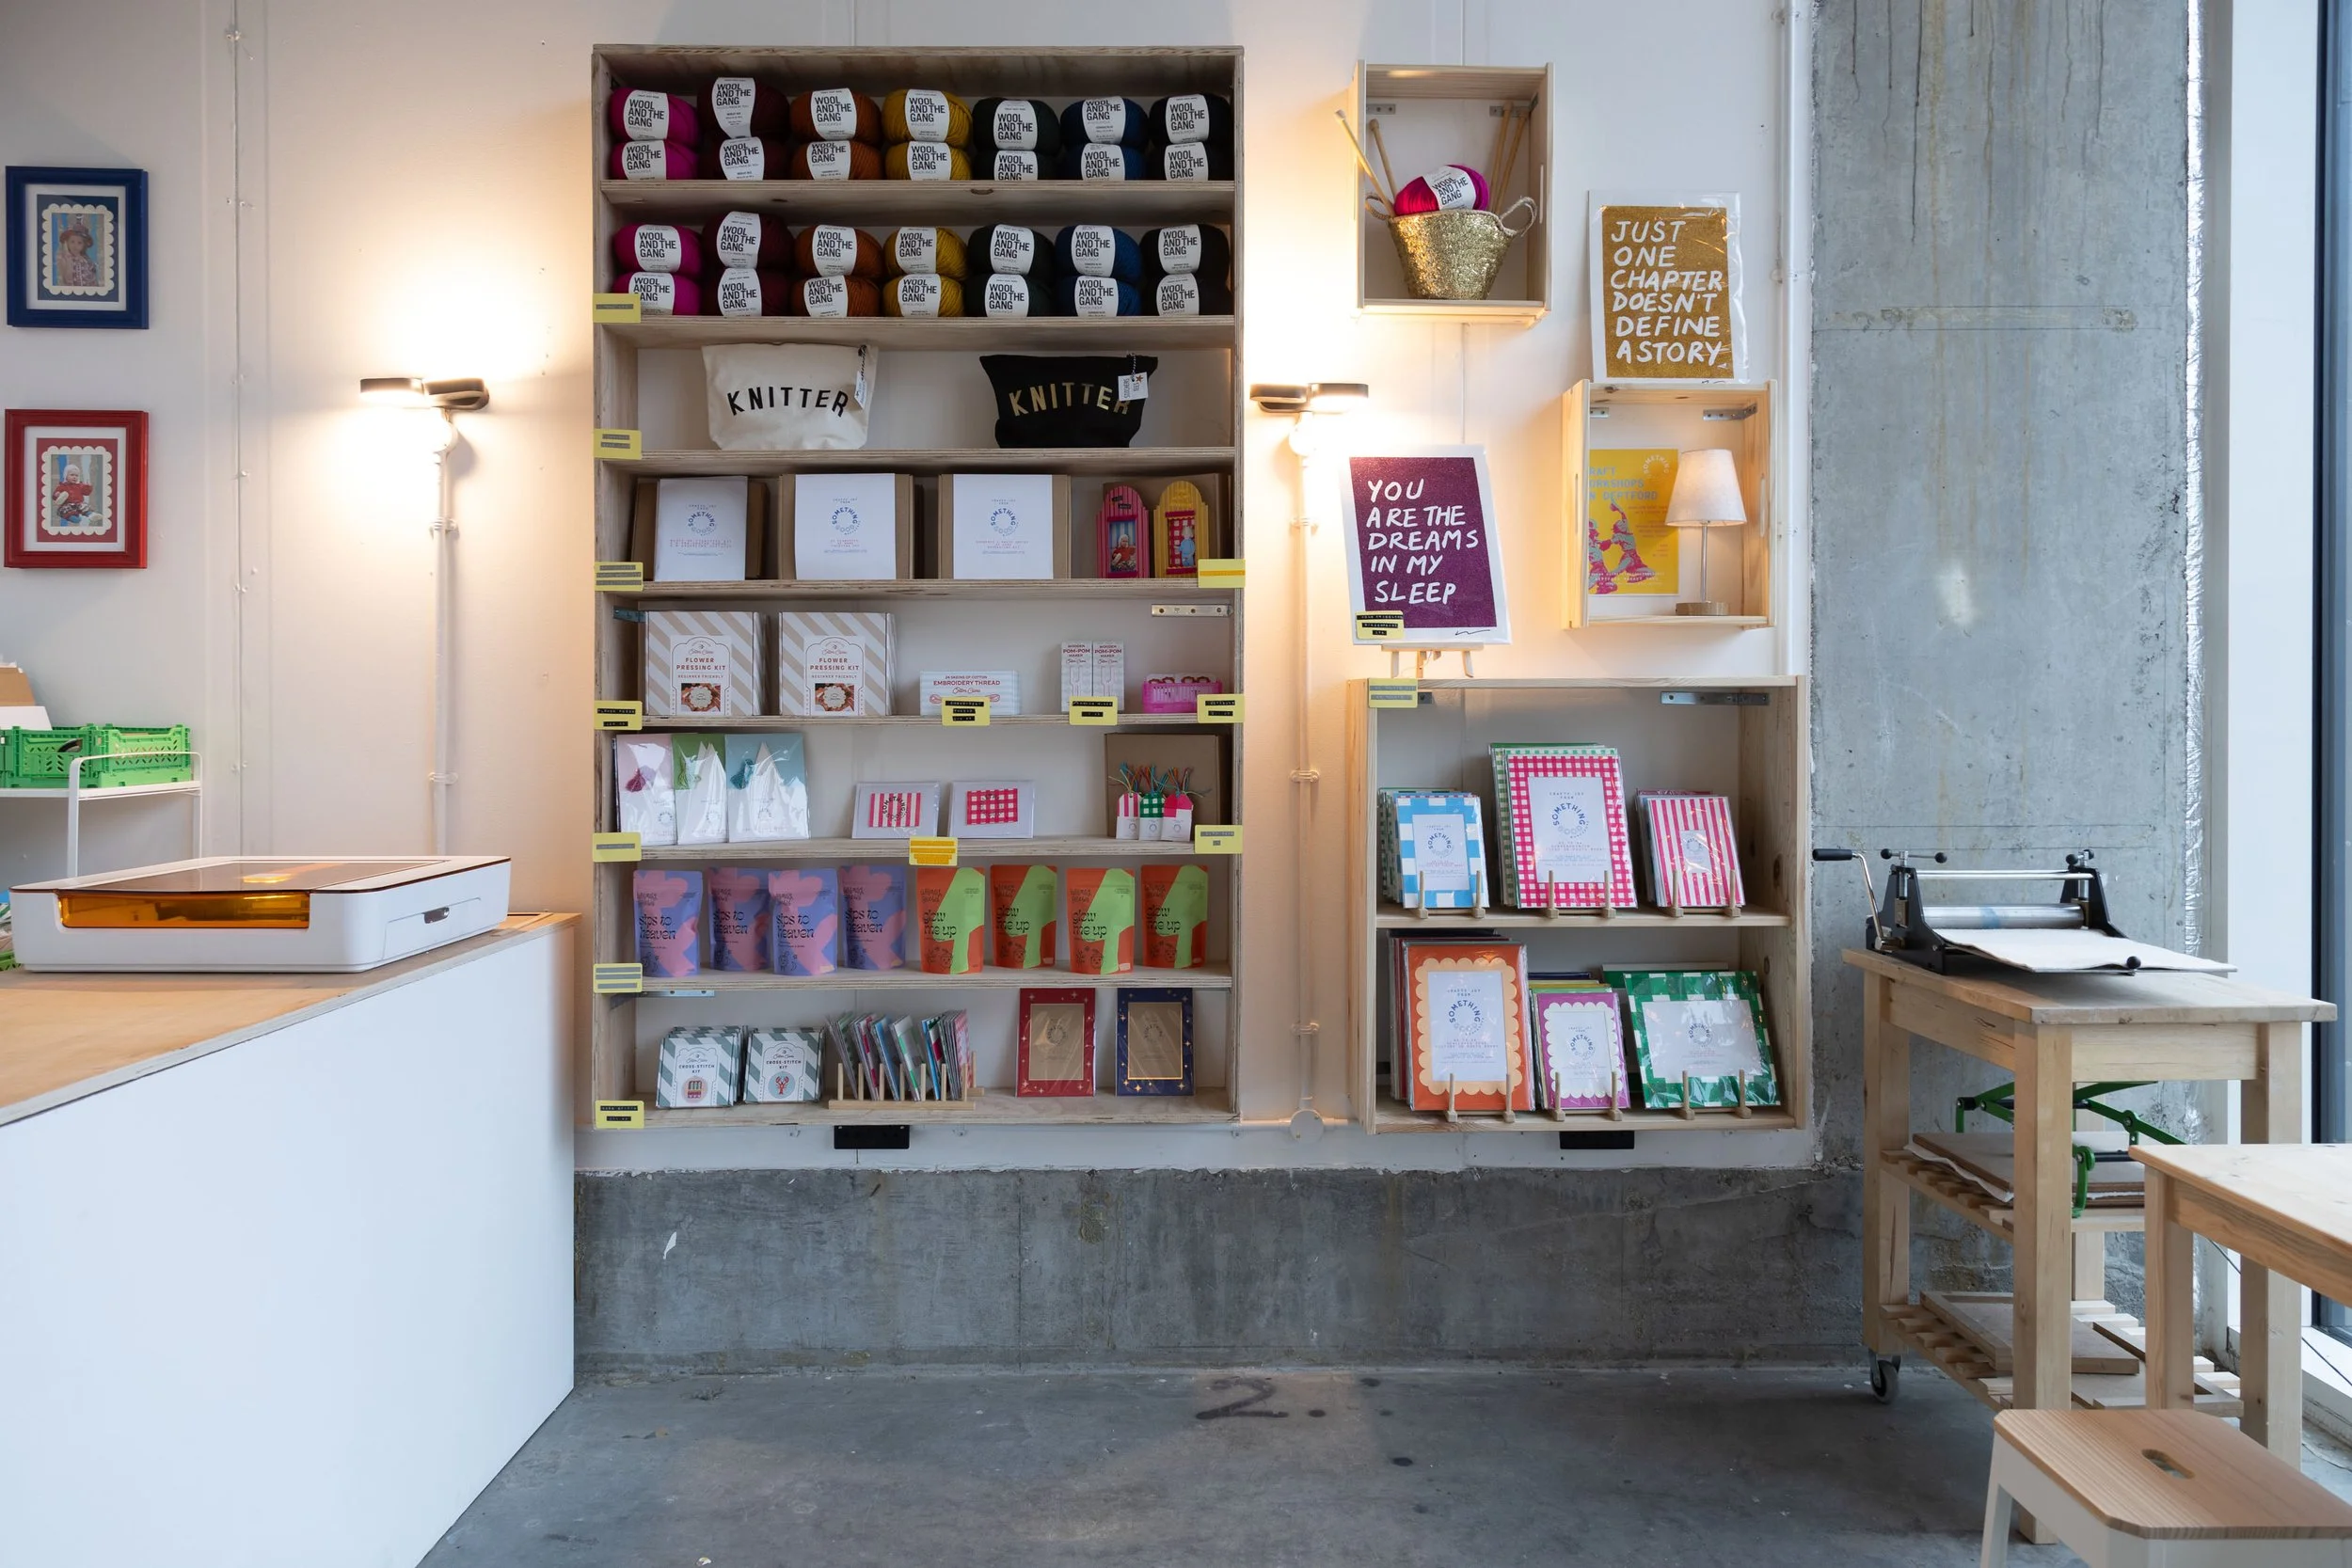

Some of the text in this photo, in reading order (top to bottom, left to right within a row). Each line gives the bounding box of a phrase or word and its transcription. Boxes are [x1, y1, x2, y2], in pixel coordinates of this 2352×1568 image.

[629, 99, 655, 109] WOOL
[716, 97, 739, 105] GANG
[815, 96, 840, 104] WOOL
[835, 103, 851, 112] THE
[930, 105, 946, 114] THE
[628, 108, 664, 119] AND THE
[817, 113, 841, 122] GANG
[911, 114, 934, 122] GANG
[997, 114, 1023, 122] WOOL
[1170, 110, 1205, 120] AND THE
[628, 117, 652, 128] GANG
[997, 122, 1033, 132] AND THE
[1170, 120, 1194, 130] GANG
[997, 132, 1022, 140] GANG
[723, 143, 748, 151] WOOL
[723, 150, 745, 158] AND
[932, 152, 947, 161] THE
[1085, 151, 1109, 160] WOOL
[724, 156, 749, 166] GANG
[1085, 158, 1120, 168] AND THE
[1086, 169, 1109, 178] GANG
[1433, 178, 1455, 190] WOOL
[1438, 177, 1468, 197] AND THE
[1441, 191, 1462, 205] GANG
[723, 227, 747, 235] WOOL
[818, 231, 843, 240] WOOL
[1163, 230, 1187, 239] WOOL
[1612, 220, 1686, 243] JUST
[639, 232, 665, 241] WOOL
[721, 234, 755, 245] AND THE
[995, 231, 1020, 242] WOOL
[661, 241, 676, 249] THE
[817, 240, 852, 249] AND THE
[918, 239, 933, 247] THE
[1014, 242, 1029, 251] THE
[1075, 239, 1110, 248] AND THE
[1163, 237, 1197, 247] AND THE
[721, 243, 744, 252] GANG
[899, 247, 922, 257] GANG
[1075, 248, 1099, 257] GANG
[1164, 247, 1186, 256] GANG
[640, 249, 665, 258] GANG
[817, 248, 841, 258] GANG
[994, 248, 1017, 259] GANG
[1613, 246, 1677, 266] ONE
[1611, 269, 1723, 292] CHAPTER
[1613, 292, 1717, 312] DOESN'T
[1615, 316, 1720, 337] DEFINE
[1616, 341, 1722, 366] A STORY
[726, 387, 849, 417] KNITTER
[1643, 454, 1670, 474] SOMETHING
[1589, 467, 1616, 475] RAFT
[1589, 479, 1644, 487] ORKSHOPS
[1368, 479, 1424, 502] YOU
[1603, 491, 1658, 500] DEPTFORD
[689, 512, 715, 527] SOMETHING
[832, 507, 858, 524] SOMETHING
[991, 508, 1016, 526] SOMETHING
[1366, 505, 1466, 529] ARE THE
[1368, 530, 1479, 551] DREAMS
[1371, 555, 1443, 576] IN MY
[1375, 580, 1456, 604] SLEEP
[1552, 803, 1585, 826] SOMETHING
[1428, 832, 1452, 849] SOMETHING
[639, 913, 673, 927] sips to
[775, 913, 809, 927] sips to
[924, 910, 946, 924] glow
[1073, 910, 1096, 924] glow
[776, 926, 814, 939] heaven
[924, 926, 957, 938] me up
[1016, 922, 1030, 933] up
[1073, 926, 1107, 938] me up
[1167, 922, 1181, 933] up
[639, 926, 676, 940] heaven
[1449, 1000, 1481, 1022] SOMETHING
[1570, 1035, 1593, 1051] SOMETHING
